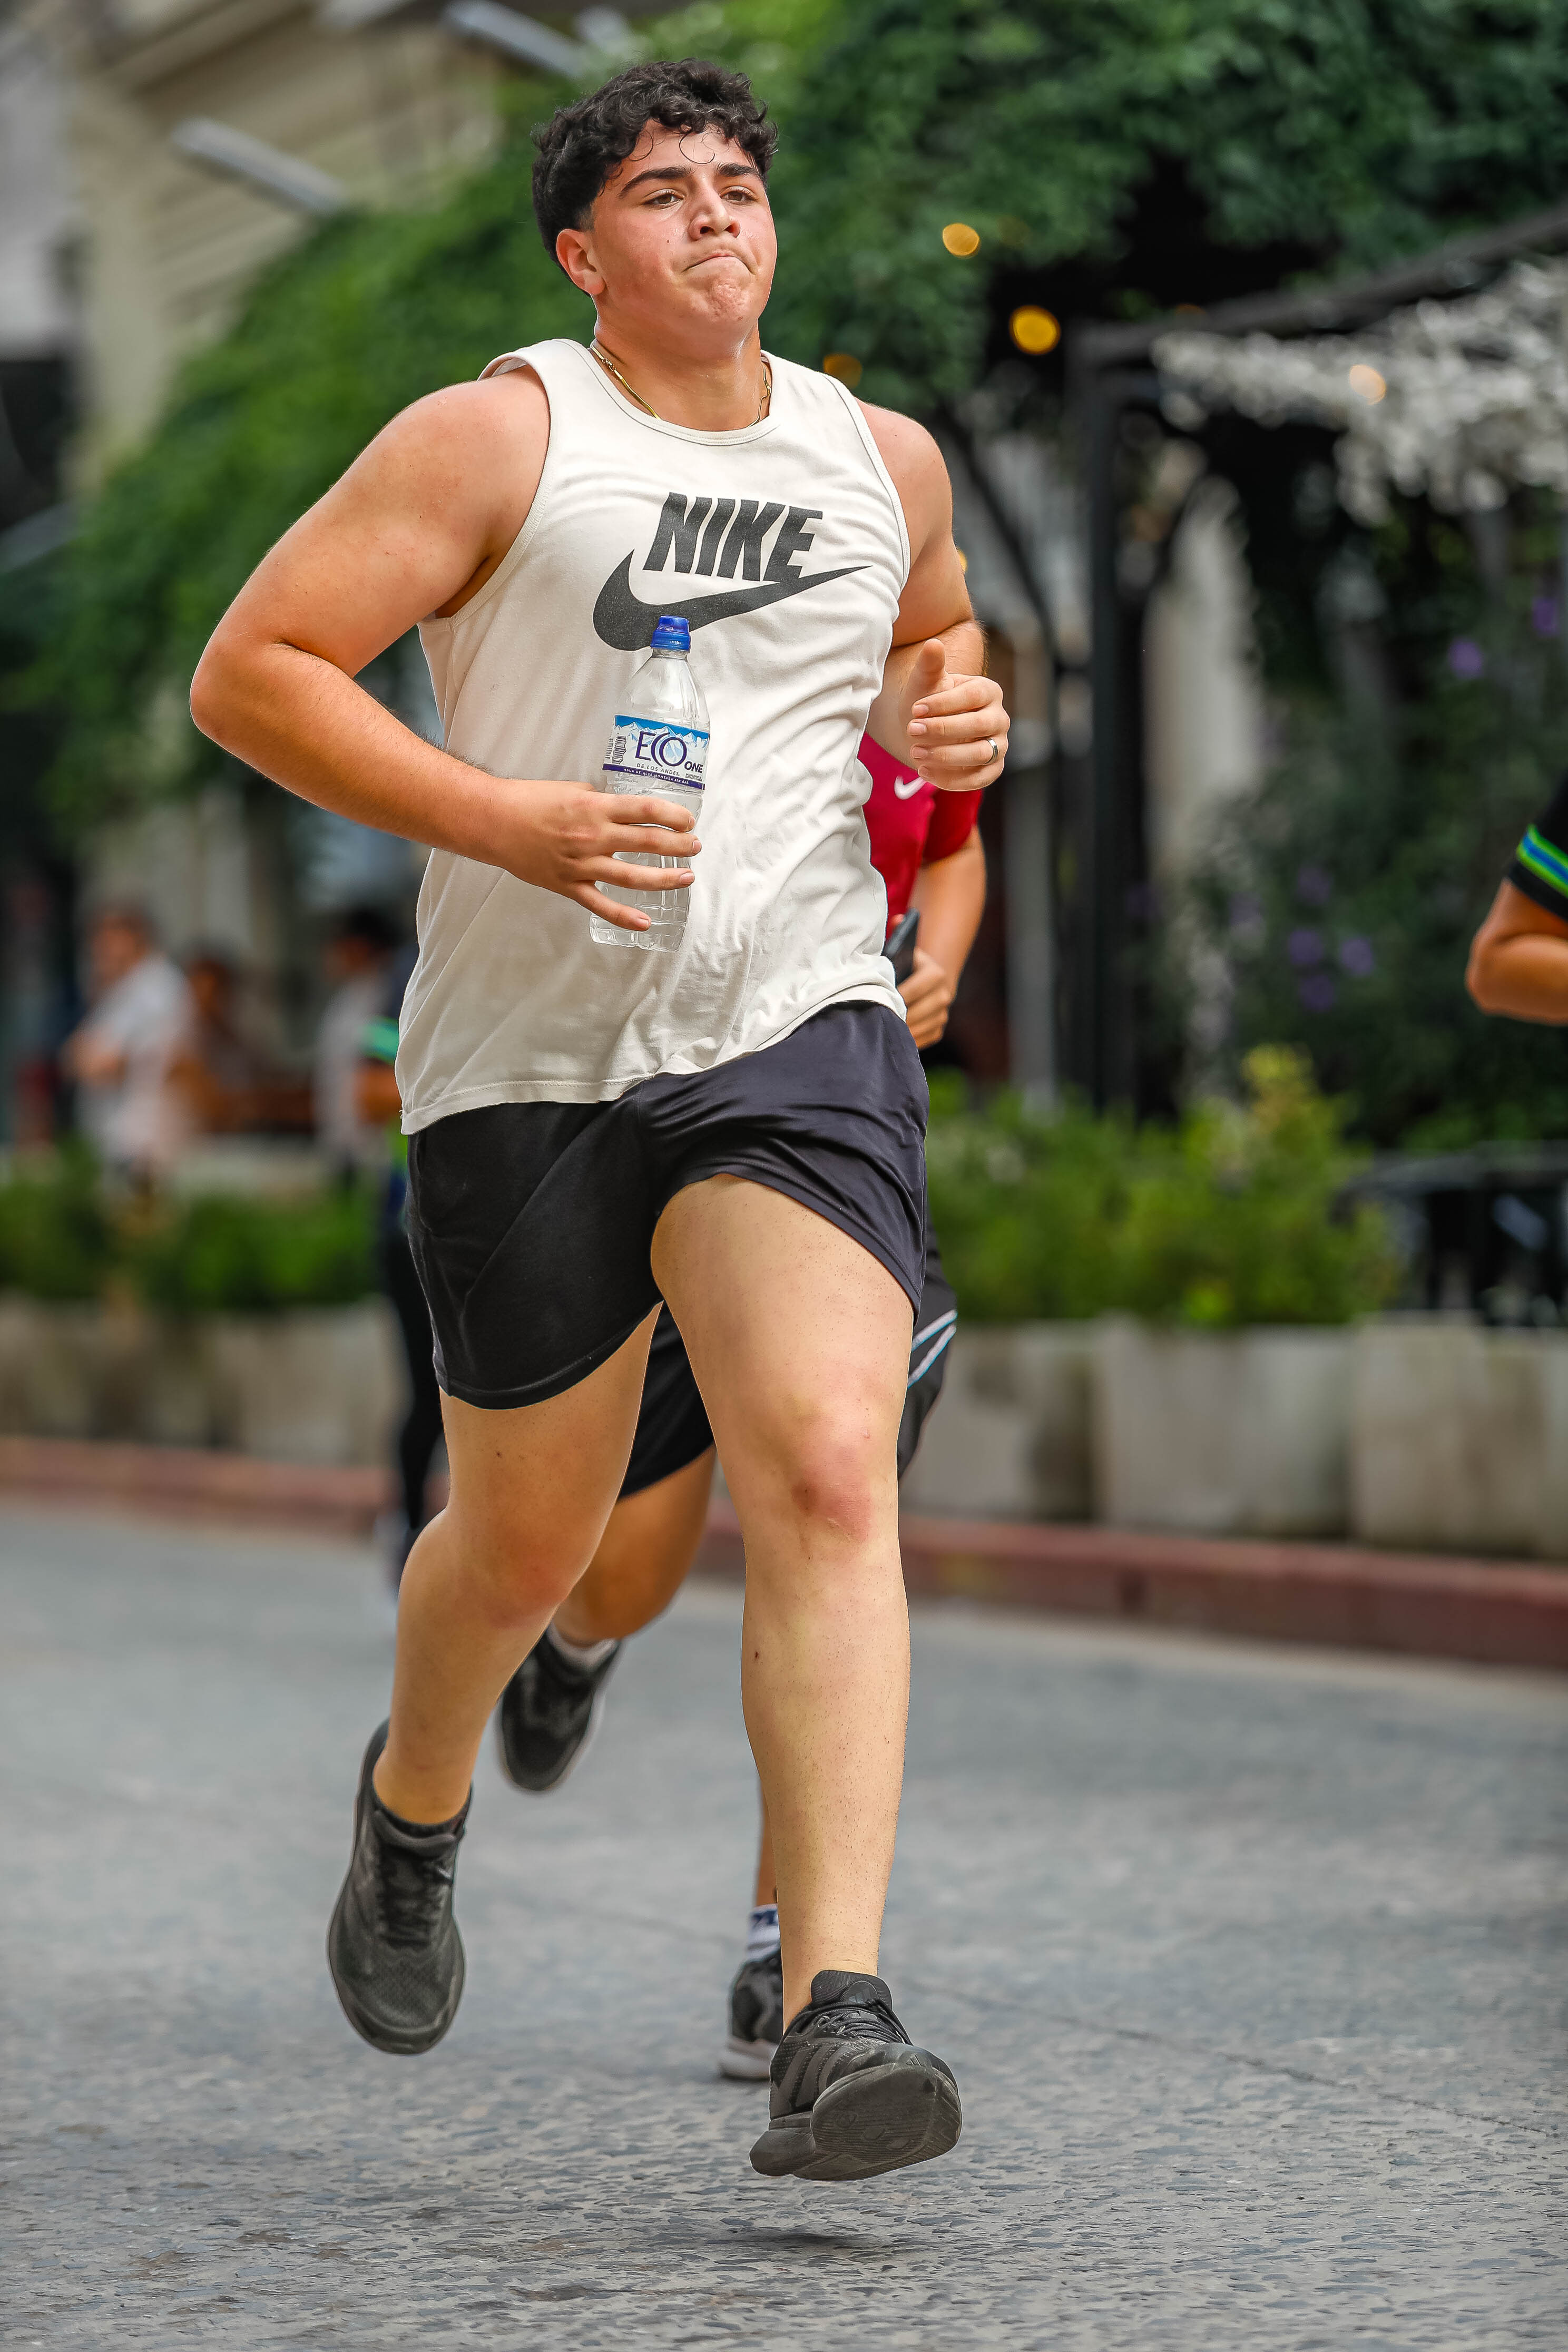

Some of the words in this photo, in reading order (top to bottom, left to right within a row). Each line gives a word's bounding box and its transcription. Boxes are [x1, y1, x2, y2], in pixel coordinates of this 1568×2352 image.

[642, 492, 823, 582] NIKE
[635, 730, 687, 768] ECO
[684, 761, 704, 773] ONE
